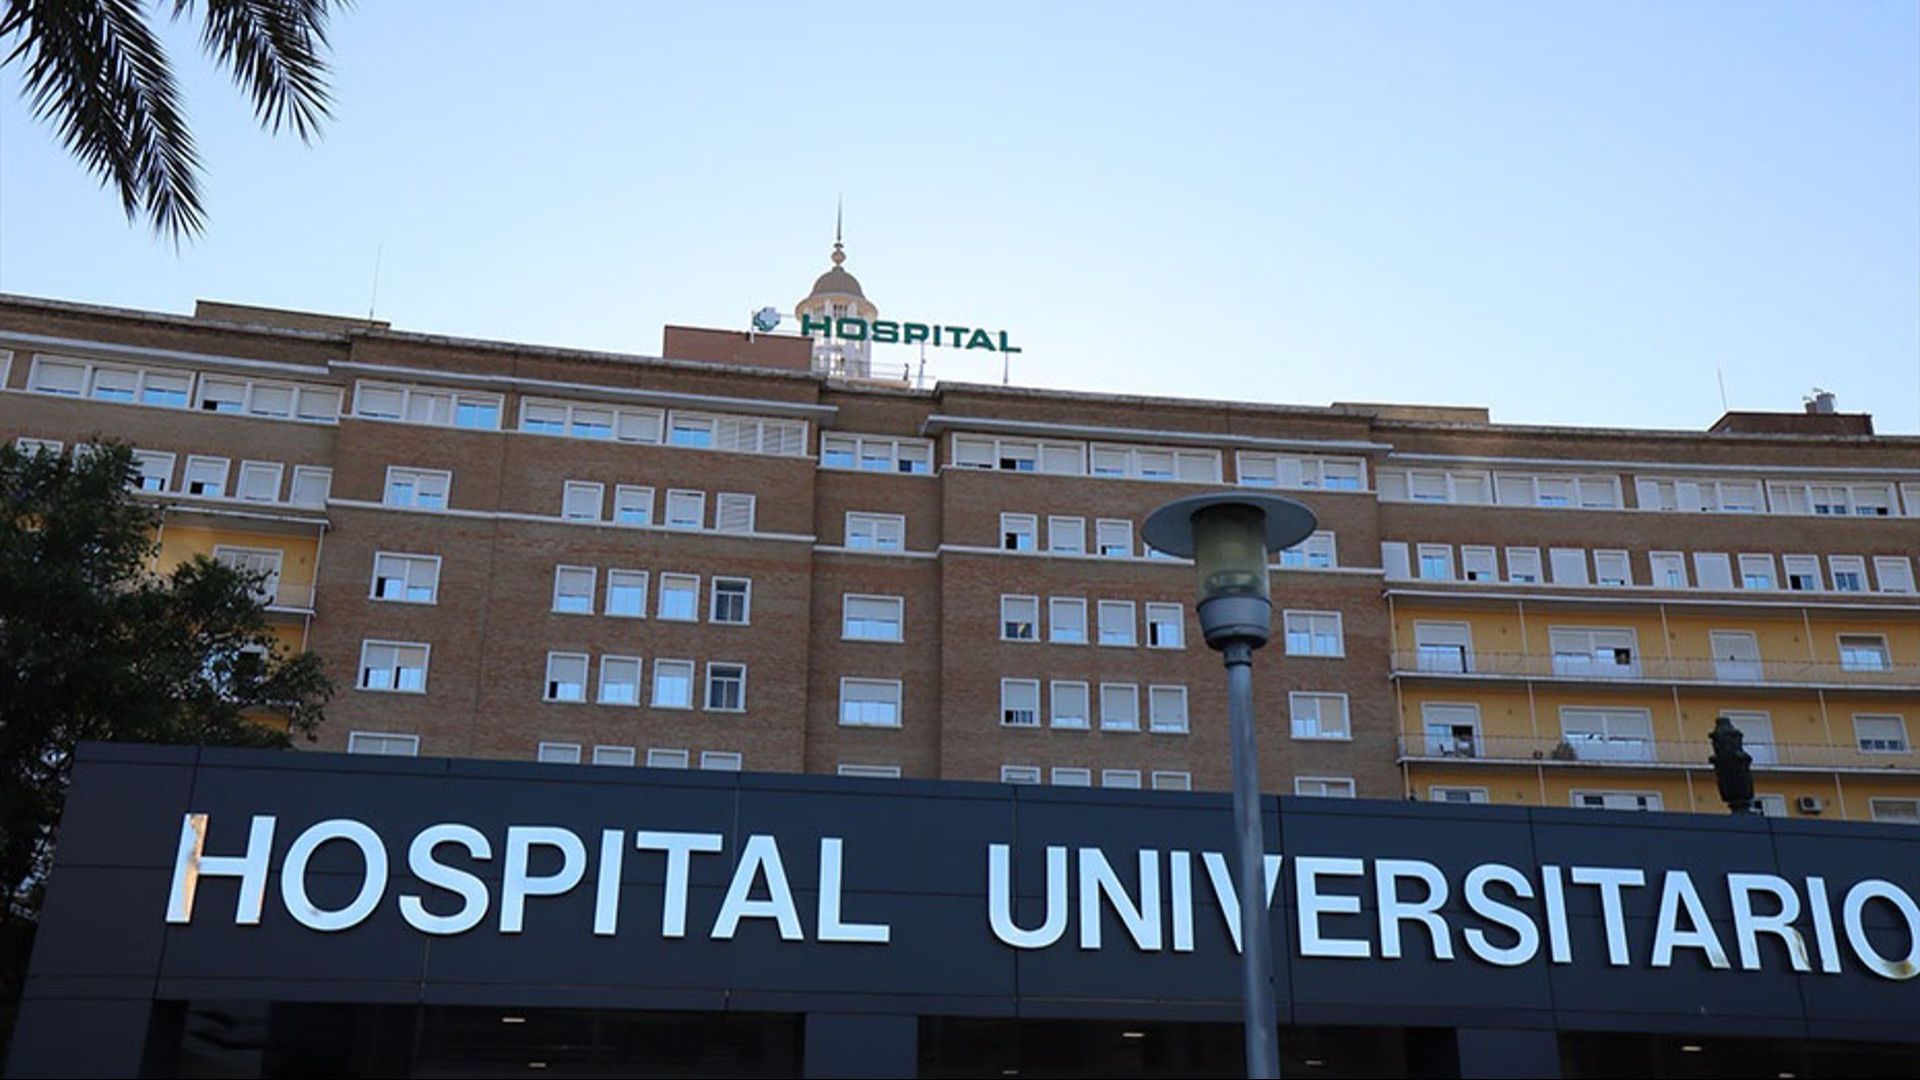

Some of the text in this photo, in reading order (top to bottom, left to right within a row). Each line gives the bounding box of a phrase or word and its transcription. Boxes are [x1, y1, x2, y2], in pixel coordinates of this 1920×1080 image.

[800, 313, 1022, 353] HOSPITAL
[165, 813, 1920, 980] HOSPITAL UNIVERSITARIO
